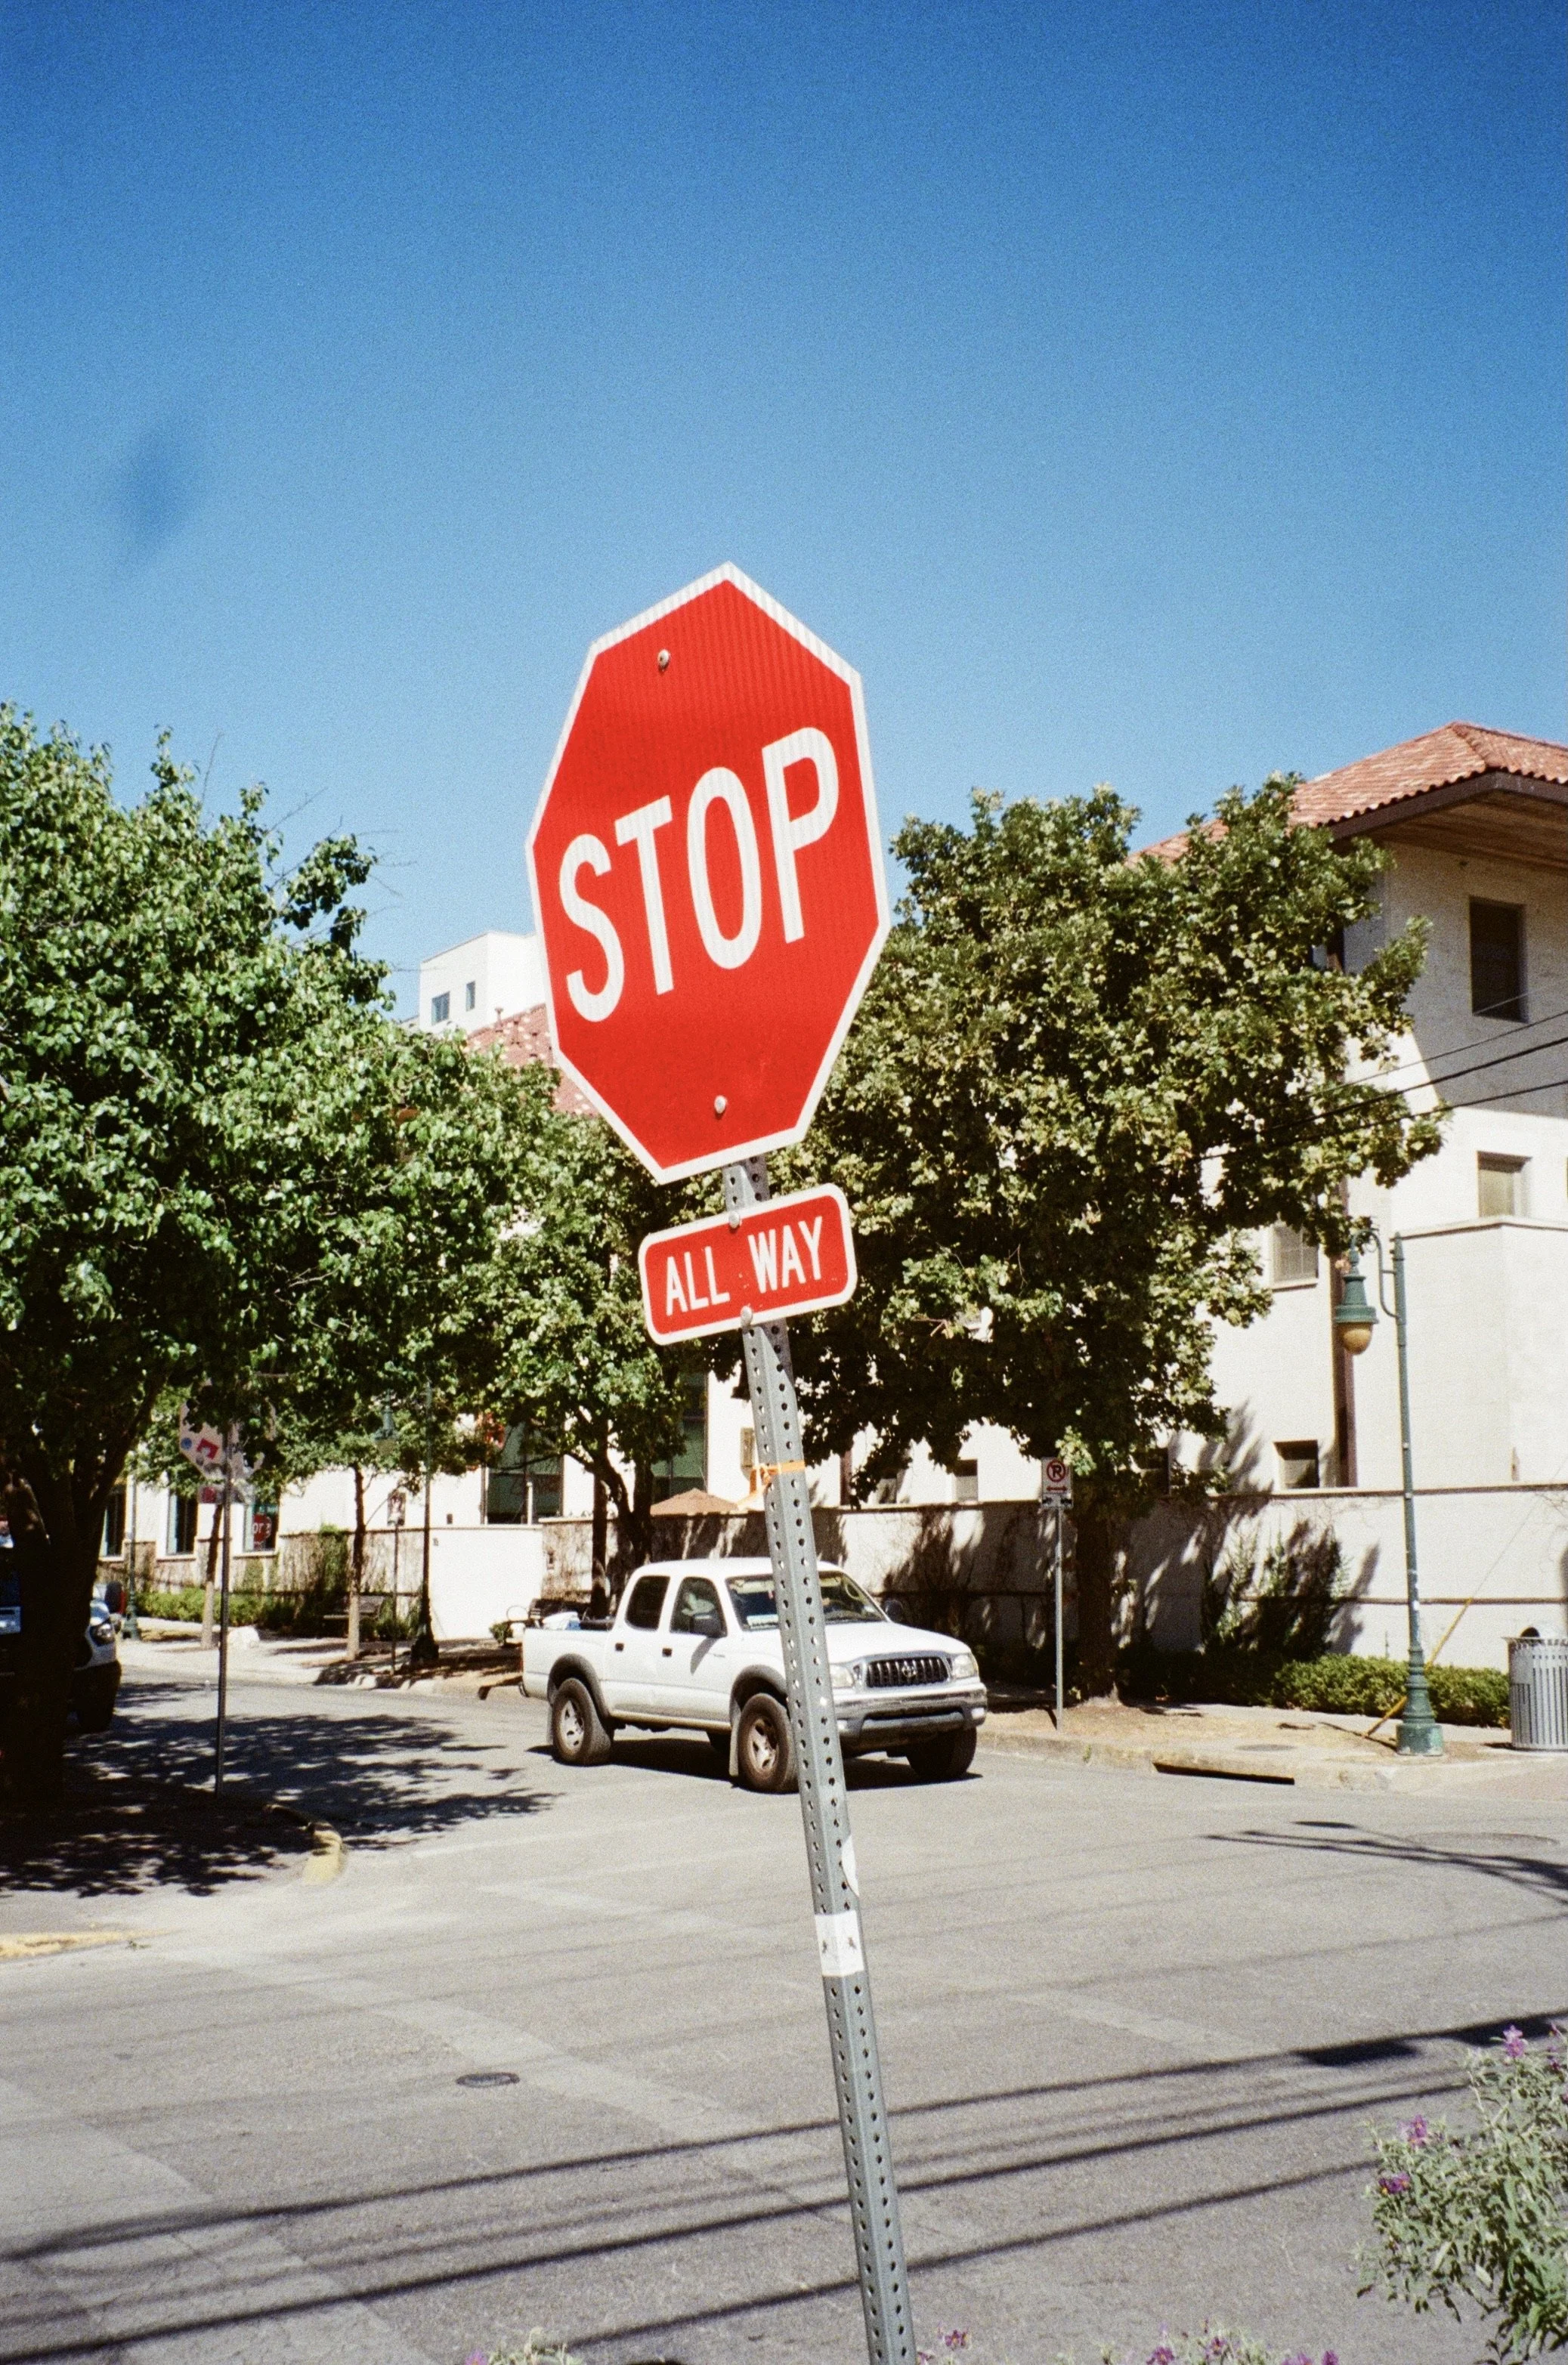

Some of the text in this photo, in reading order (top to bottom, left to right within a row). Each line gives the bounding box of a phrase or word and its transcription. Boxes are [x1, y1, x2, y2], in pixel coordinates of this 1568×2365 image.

[558, 727, 840, 1022] STOP
[666, 1216, 823, 1316] ALL WAY
